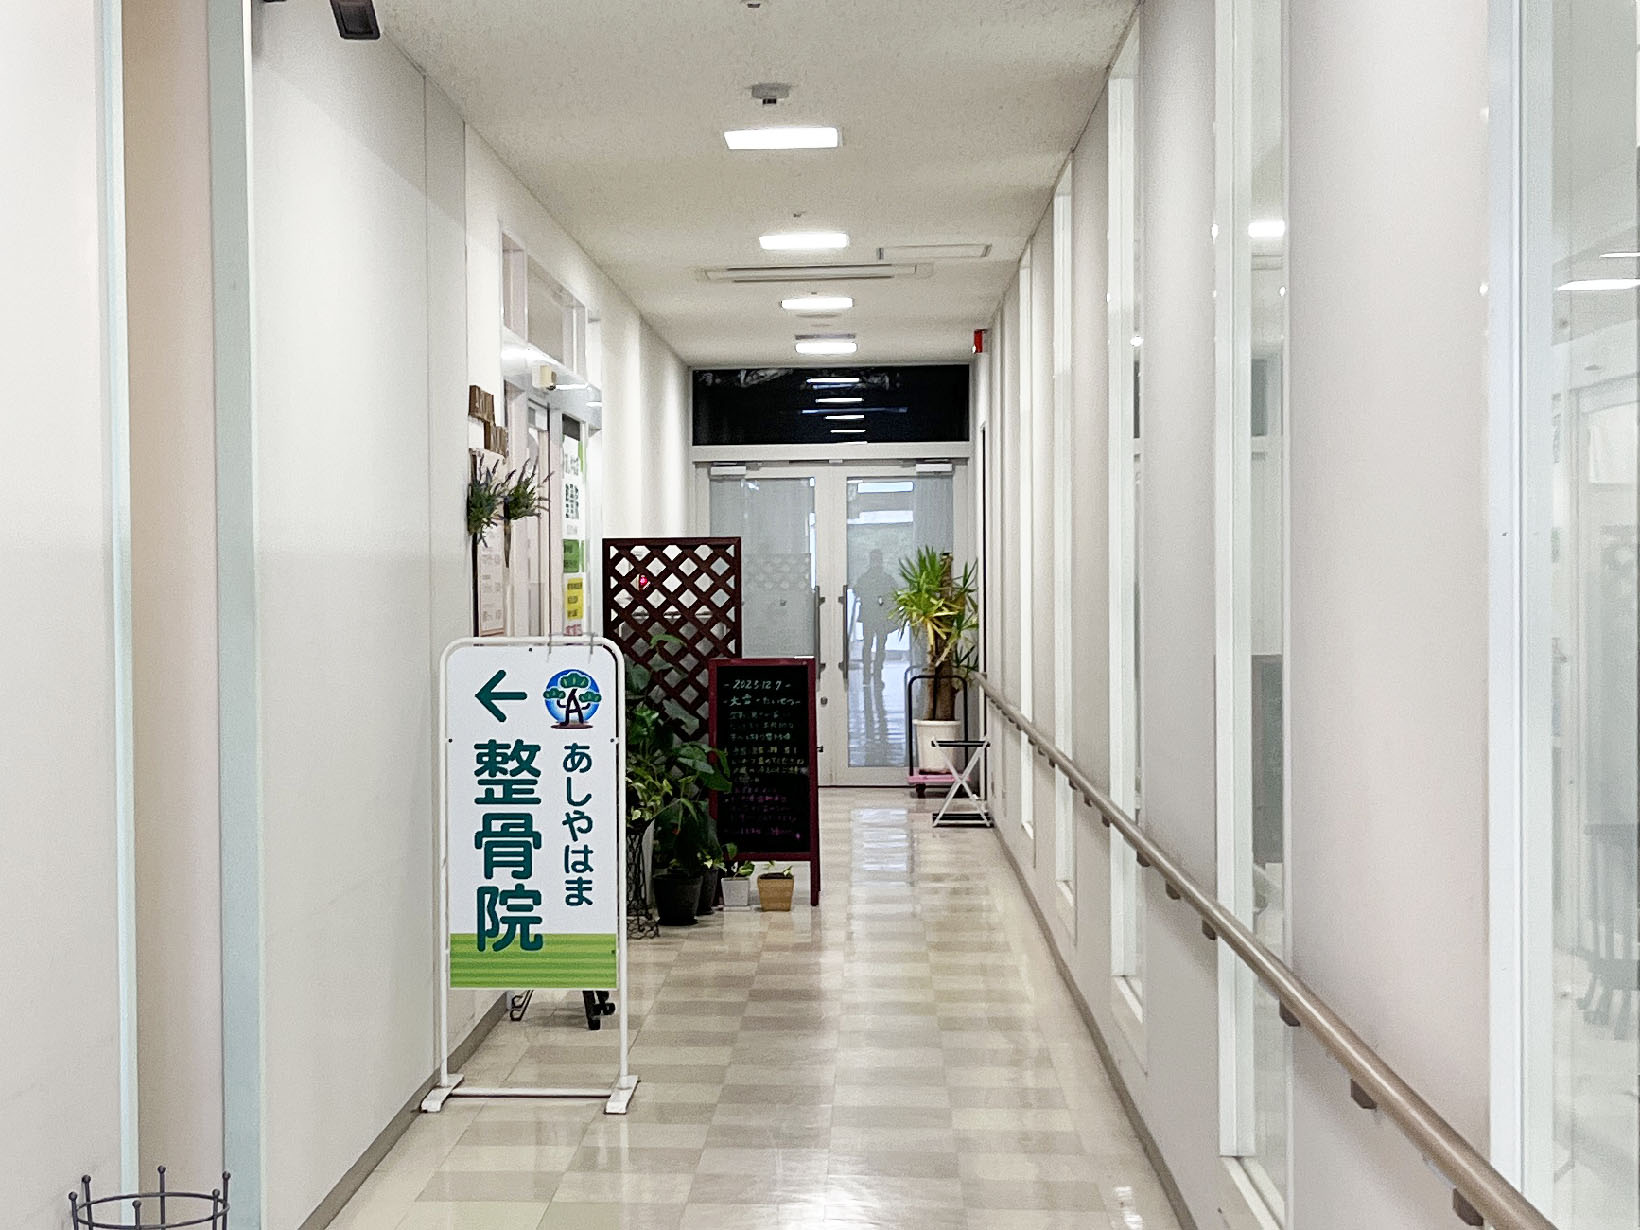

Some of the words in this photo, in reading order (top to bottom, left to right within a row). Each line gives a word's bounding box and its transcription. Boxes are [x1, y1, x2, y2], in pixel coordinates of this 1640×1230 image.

[474, 739, 543, 952] 整骨院
[562, 743, 594, 906] あしやはま
